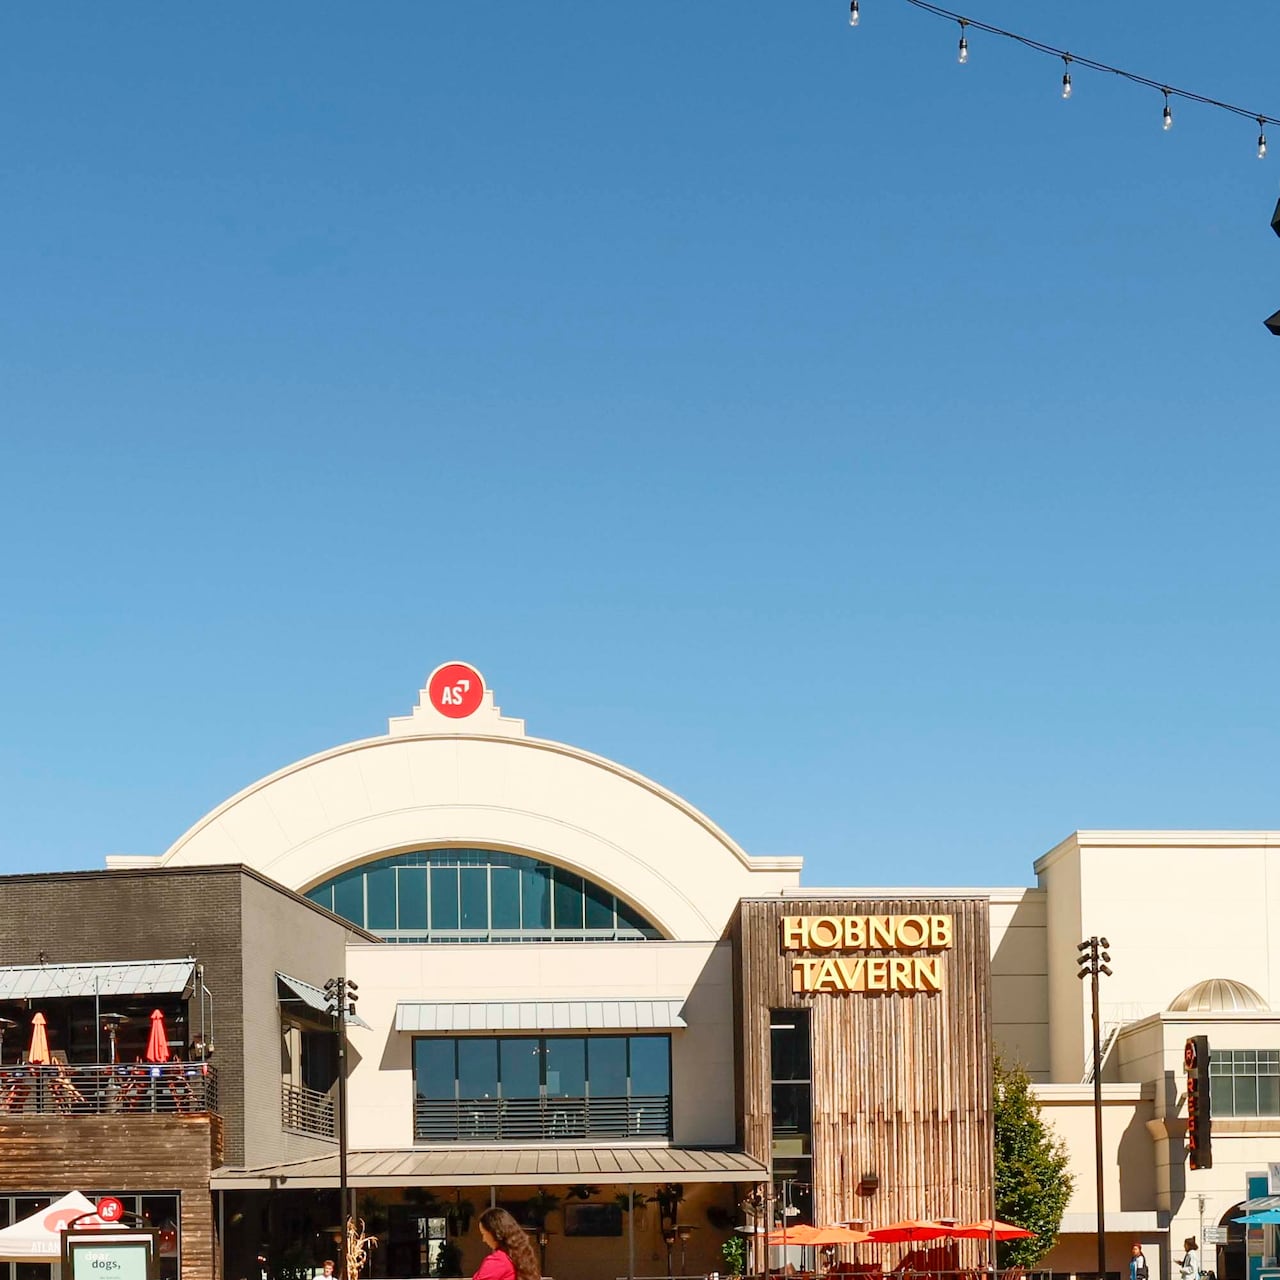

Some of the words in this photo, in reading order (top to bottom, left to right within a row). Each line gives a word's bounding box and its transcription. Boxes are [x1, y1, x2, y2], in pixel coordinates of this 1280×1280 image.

[441, 686, 463, 705] AS
[782, 915, 952, 950] HOBNOB
[793, 958, 942, 991] TAVERN
[91, 1259, 122, 1271] dogs,
